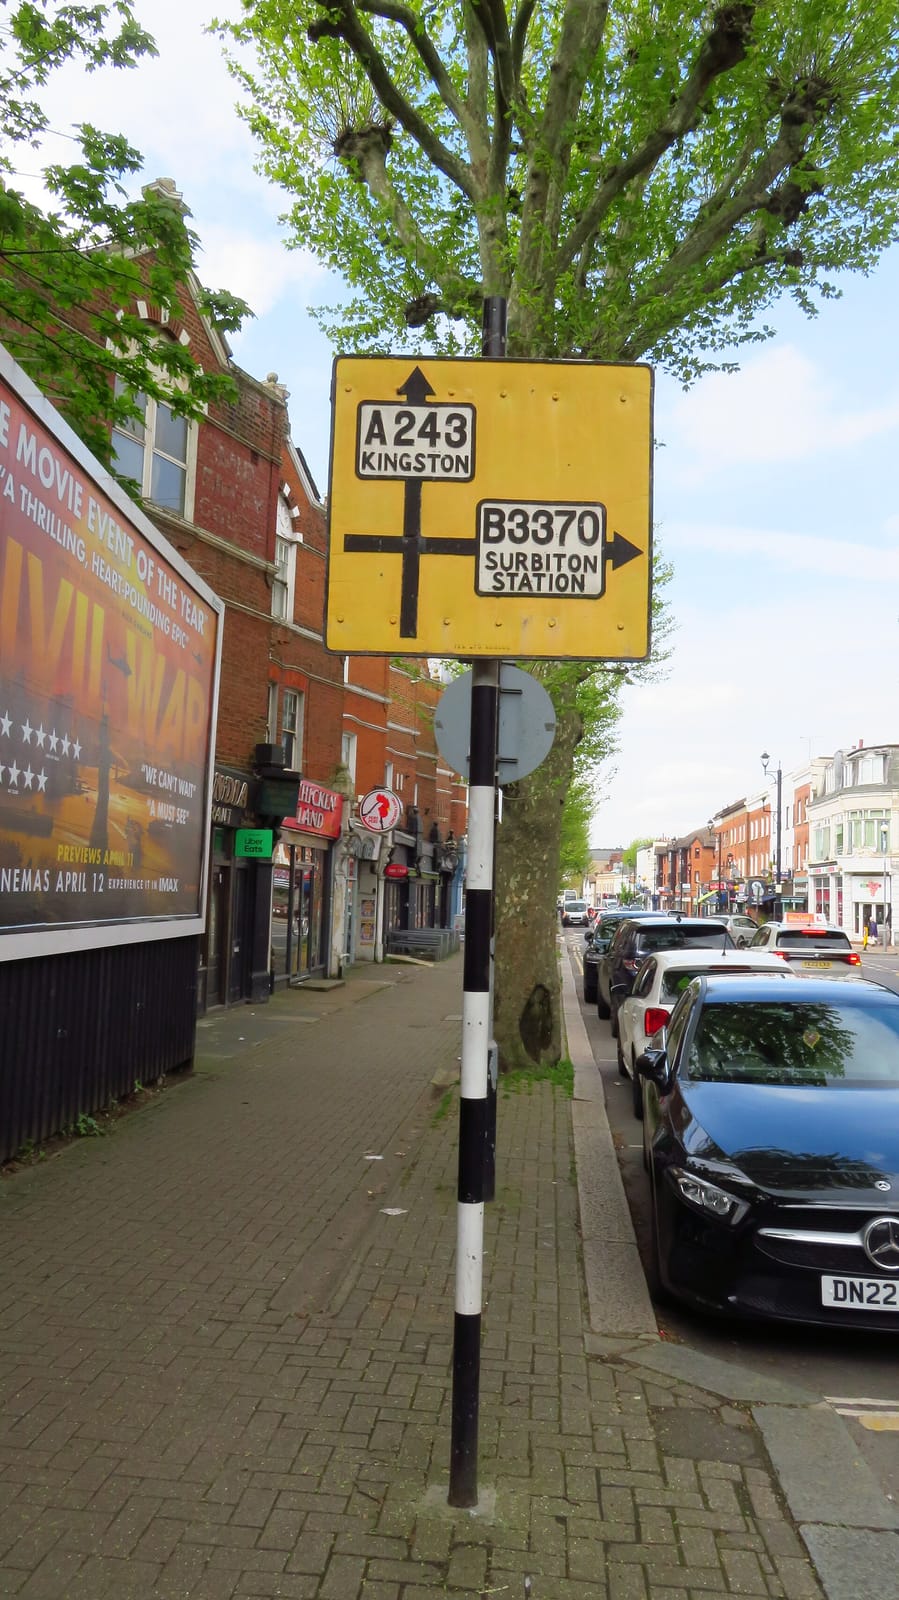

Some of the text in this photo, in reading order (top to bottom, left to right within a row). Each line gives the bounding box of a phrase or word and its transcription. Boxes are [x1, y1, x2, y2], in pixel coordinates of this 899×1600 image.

[364, 409, 468, 448] A243
[361, 451, 469, 474] KINGSTON
[16, 424, 84, 520] MOVIE
[87, 496, 134, 567] EVENT
[136, 550, 154, 586] OF
[157, 567, 177, 610] THE
[482, 508, 600, 547] B3370
[20, 484, 88, 569] THRILLING,
[91, 552, 170, 635] HEART-POUNDING
[485, 551, 598, 574] SURBITON
[492, 572, 586, 593] STATION
[297, 806, 324, 829] LAND
[244, 837, 263, 845] Uber
[57, 844, 134, 868] PREVIEWS APRIL 11
[0, 867, 104, 893] NEMAS APRIL 12
[108, 878, 144, 890] EXPERIENCE
[158, 877, 179, 893] IMAX
[833, 1279, 897, 1306] DN22
